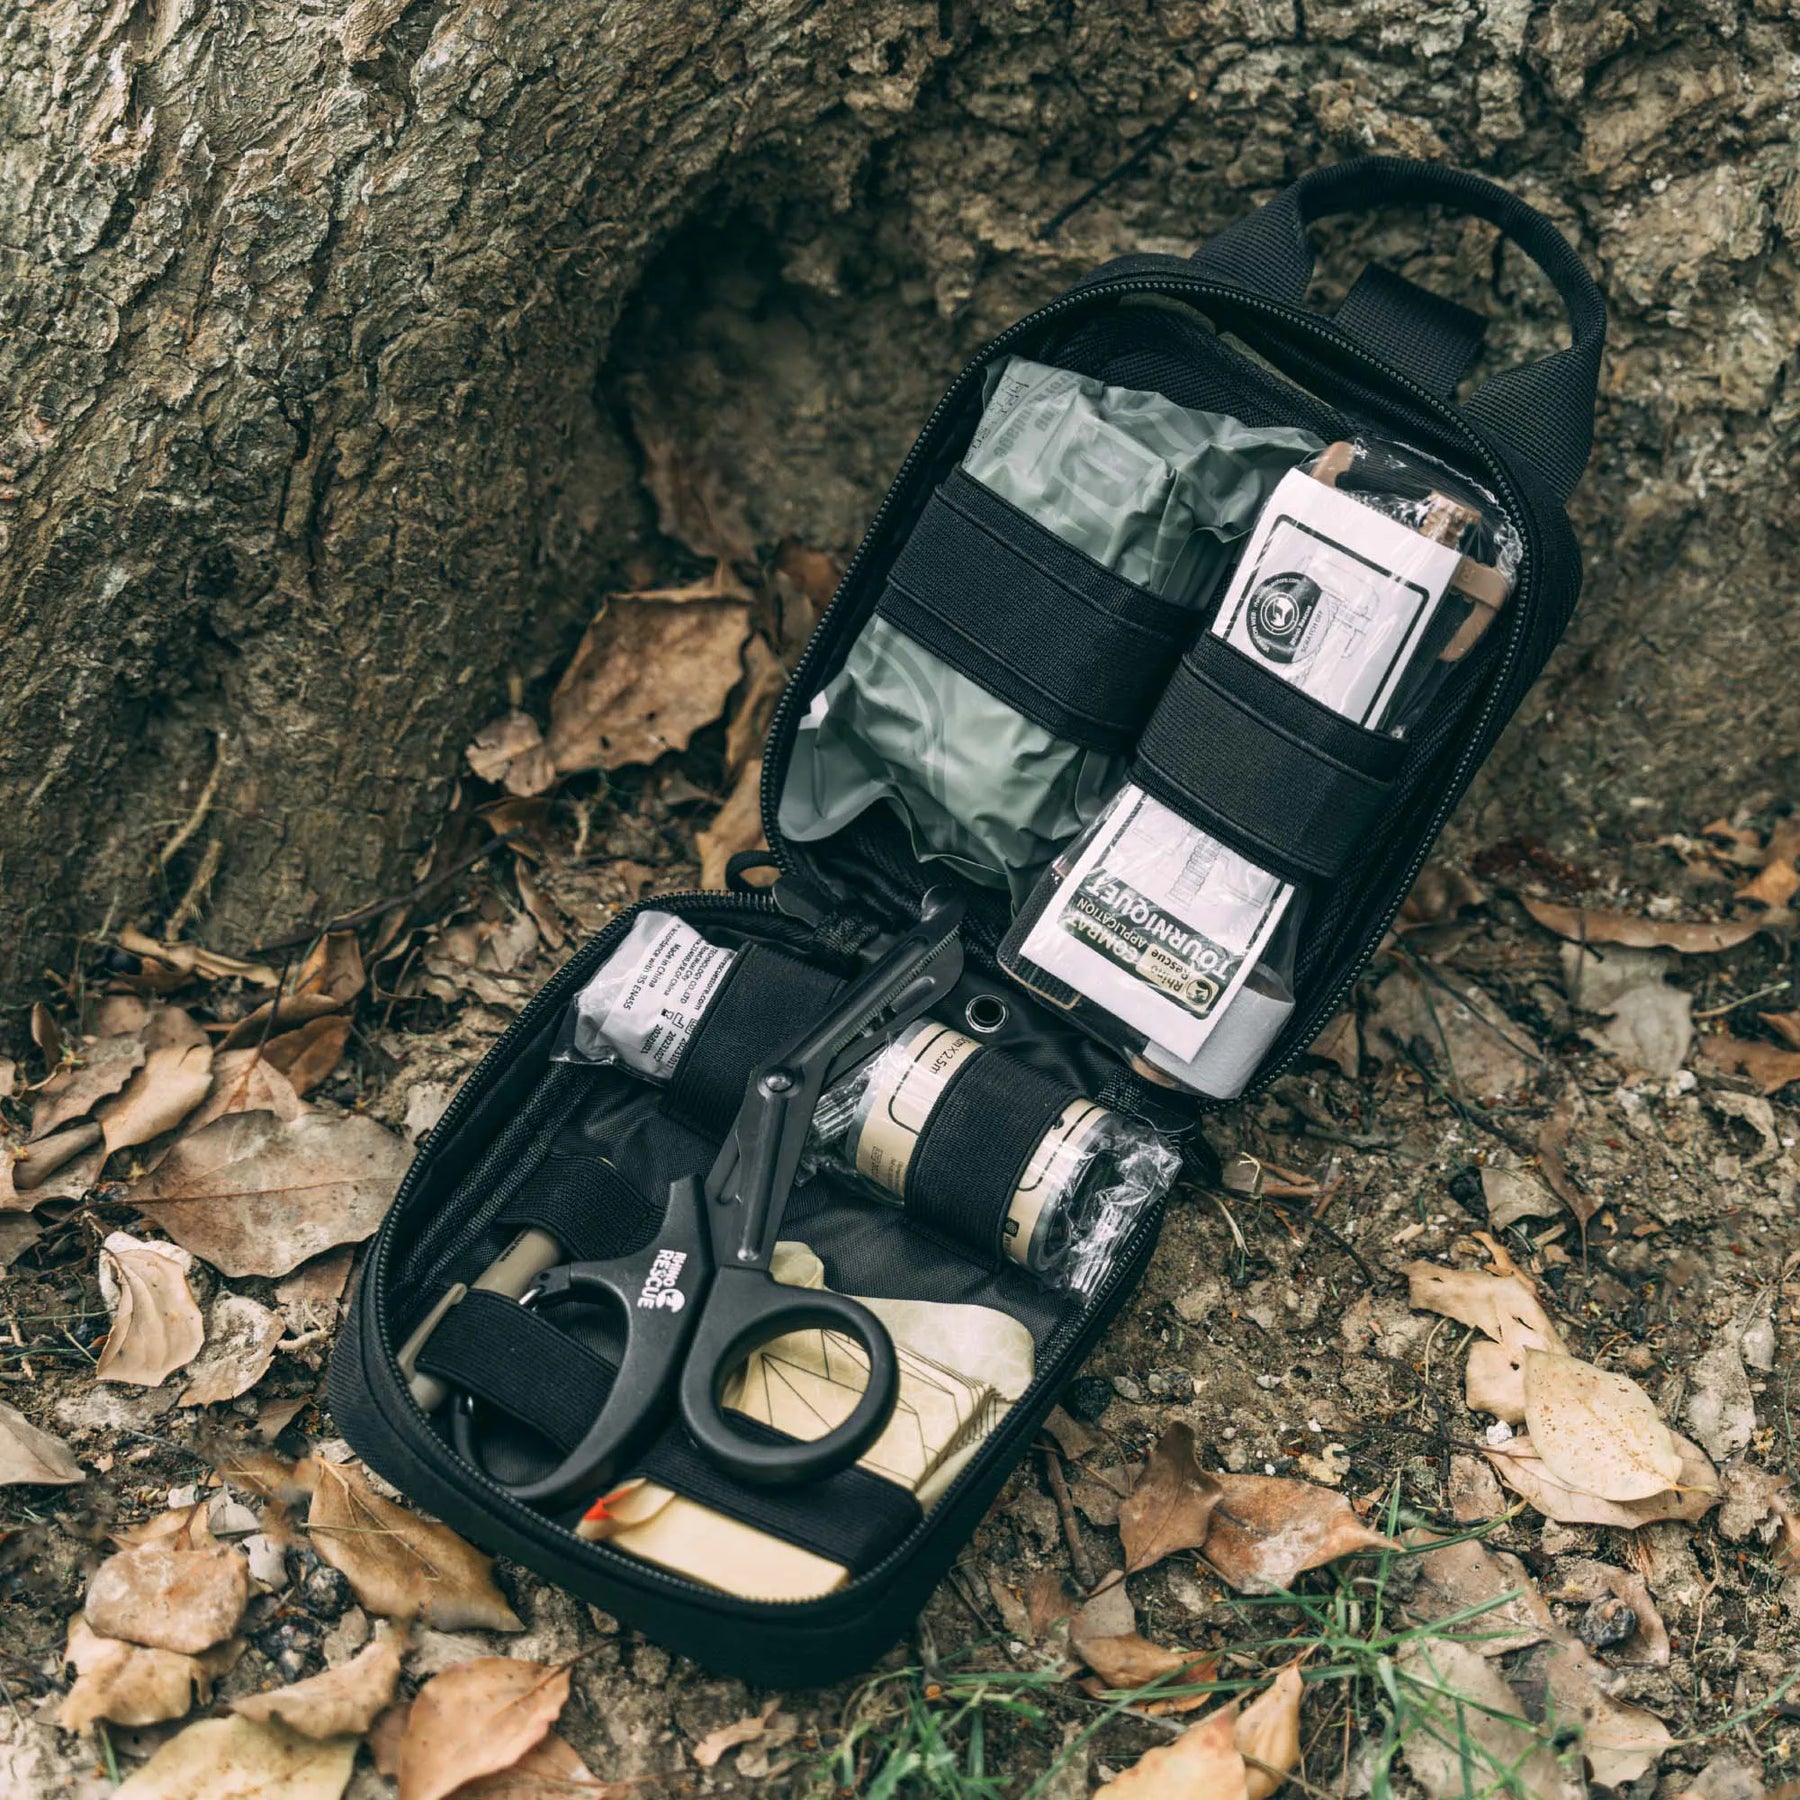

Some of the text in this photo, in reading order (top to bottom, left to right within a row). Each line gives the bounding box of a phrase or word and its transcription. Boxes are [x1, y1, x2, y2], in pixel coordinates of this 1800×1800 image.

[1063, 908, 1140, 965] COMBAT
[1074, 896, 1148, 950] APPLICATION
[1083, 873, 1228, 980] TOURNIQUET
[660, 957, 671, 968] in
[664, 941, 681, 961] Made
[1148, 948, 1191, 981] Rescue
[647, 964, 666, 989] China
[662, 978, 677, 997] China
[1148, 963, 1184, 993] Rhino
[621, 983, 642, 1010] EN455
[636, 1249, 674, 1309] RESCUE
[662, 1251, 687, 1287] RHINO
